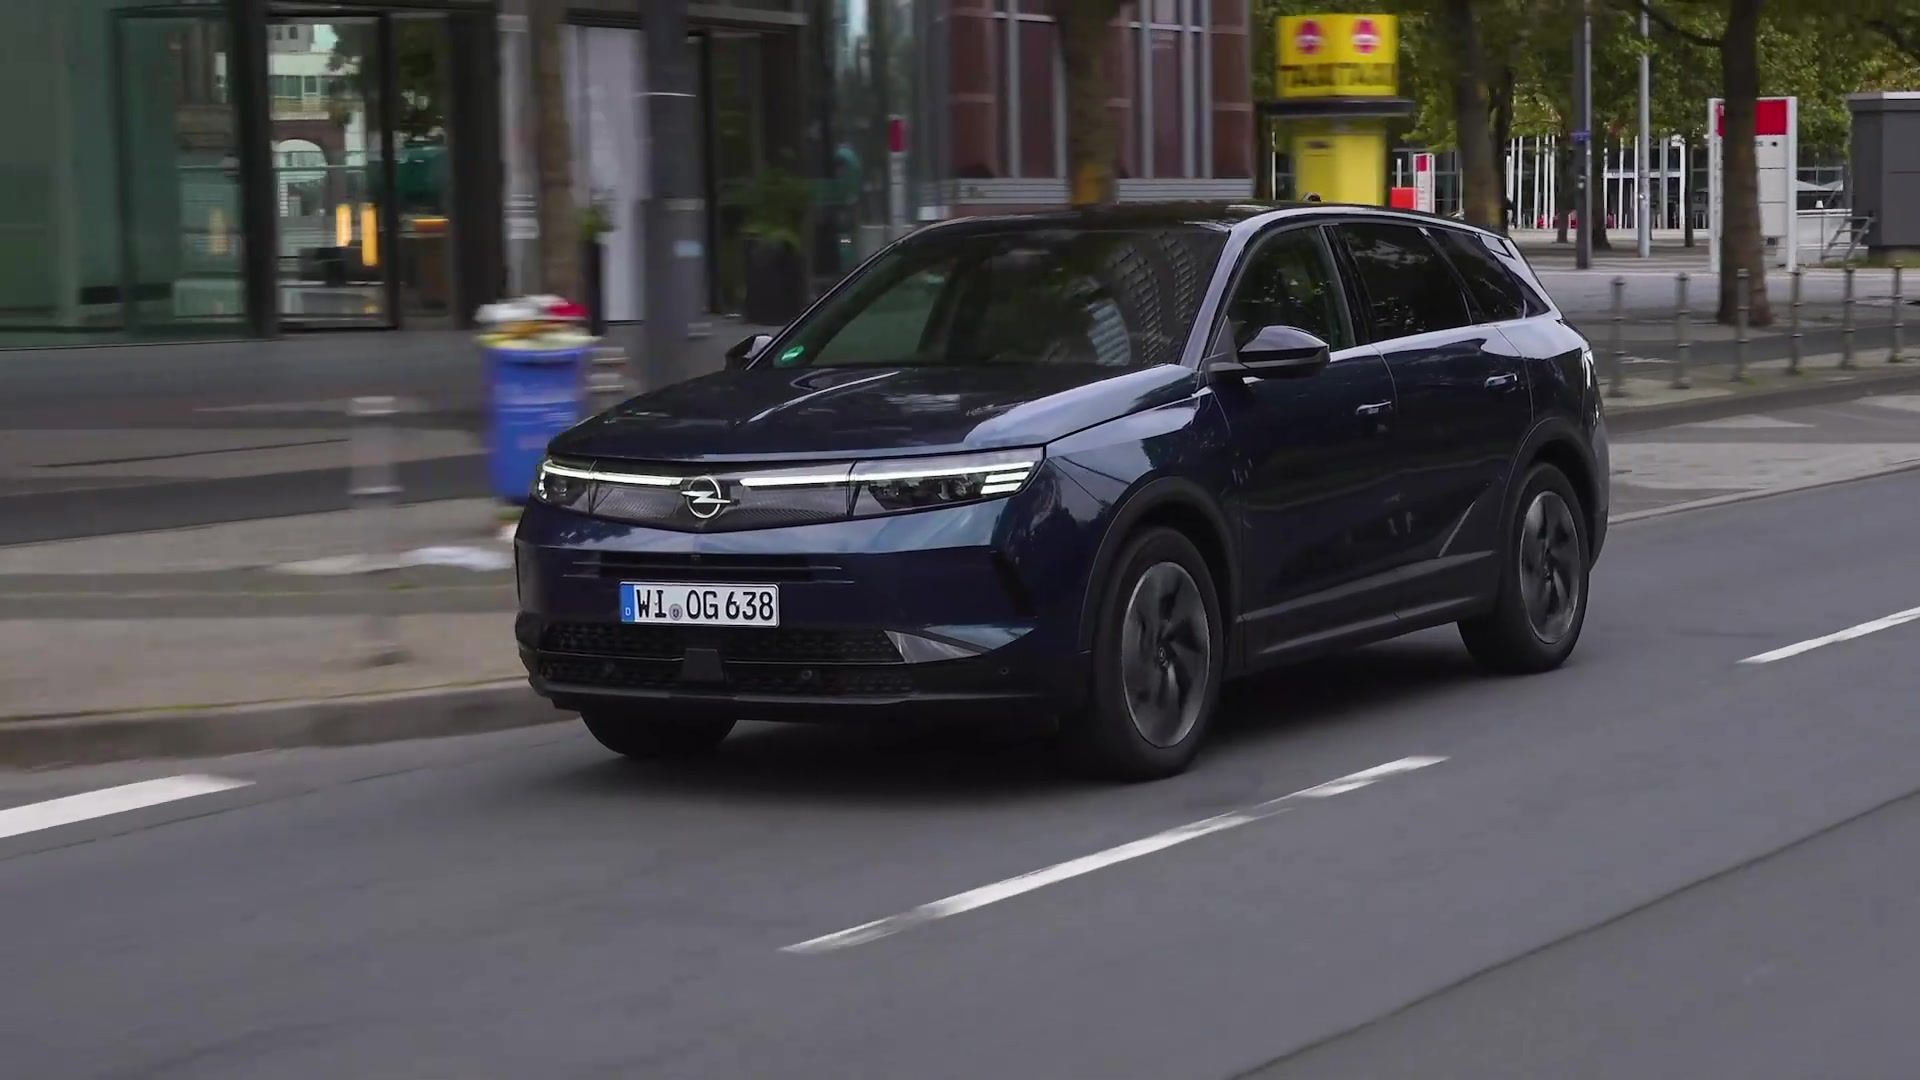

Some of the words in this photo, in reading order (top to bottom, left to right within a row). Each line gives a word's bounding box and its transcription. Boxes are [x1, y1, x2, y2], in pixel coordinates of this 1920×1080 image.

[624, 607, 631, 617] D
[636, 589, 667, 618] WI
[686, 590, 719, 620] OG
[725, 591, 774, 621] 638
